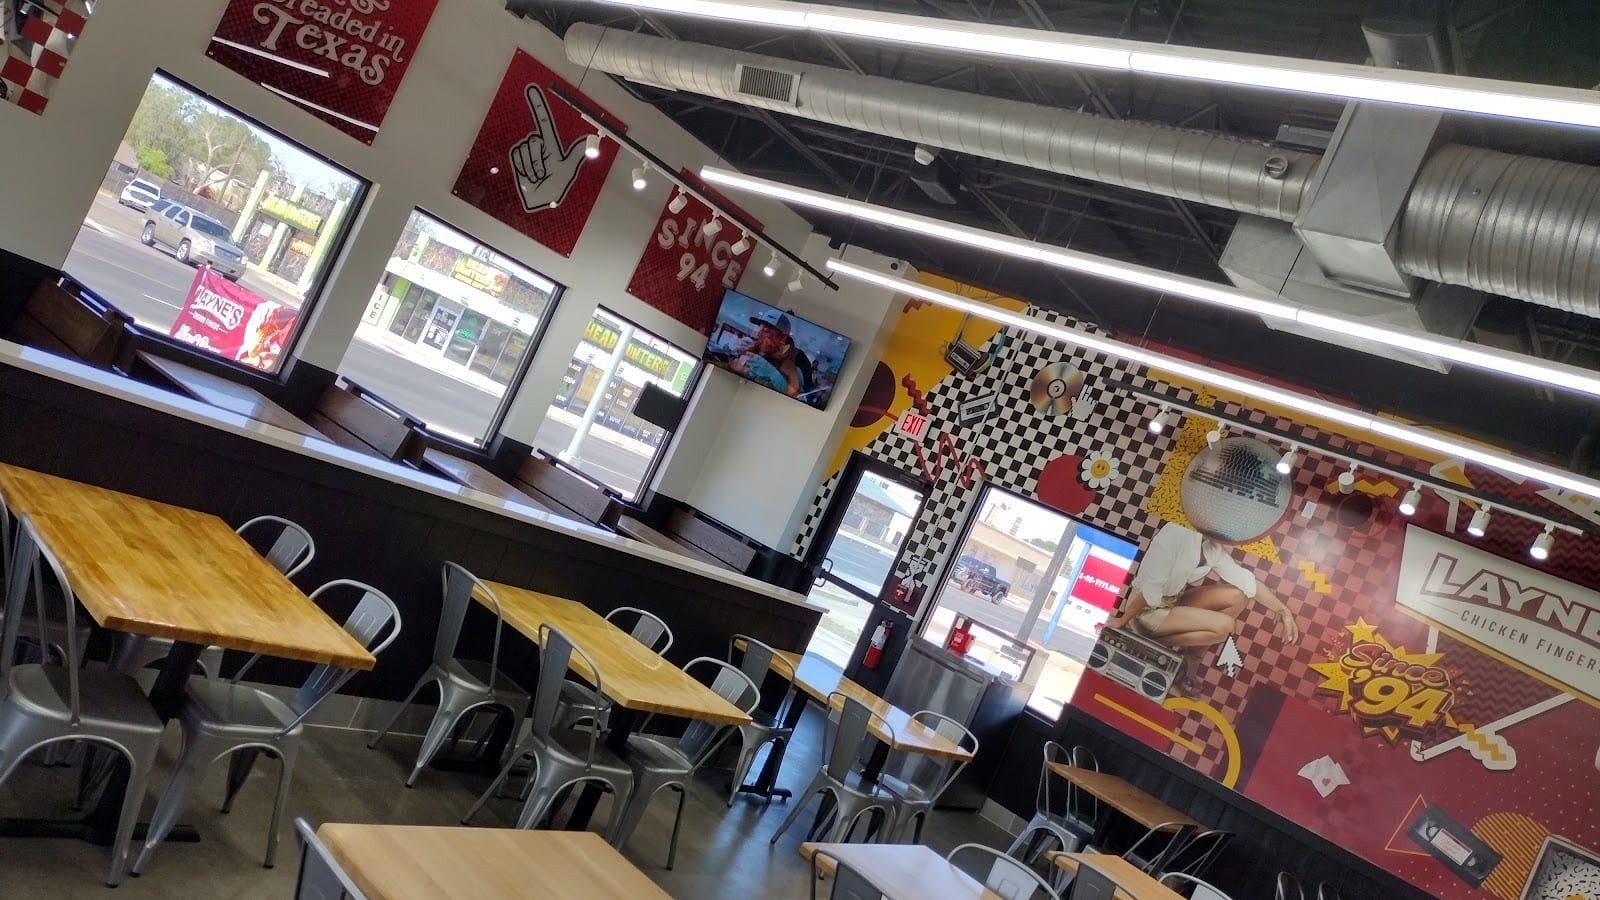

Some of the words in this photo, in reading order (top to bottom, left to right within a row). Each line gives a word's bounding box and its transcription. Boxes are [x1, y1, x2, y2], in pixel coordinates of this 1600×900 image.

[253, 2, 390, 85] Texas
[377, 25, 405, 62] in
[657, 217, 740, 289] SINCE
[677, 252, 709, 292] 94
[583, 320, 620, 350] HEAD
[901, 413, 927, 436] EXIT
[1460, 609, 1529, 645] CHICKEN
[1536, 638, 1600, 675] FINGER
[1341, 643, 1449, 688] Since
[1354, 668, 1451, 727] '94
